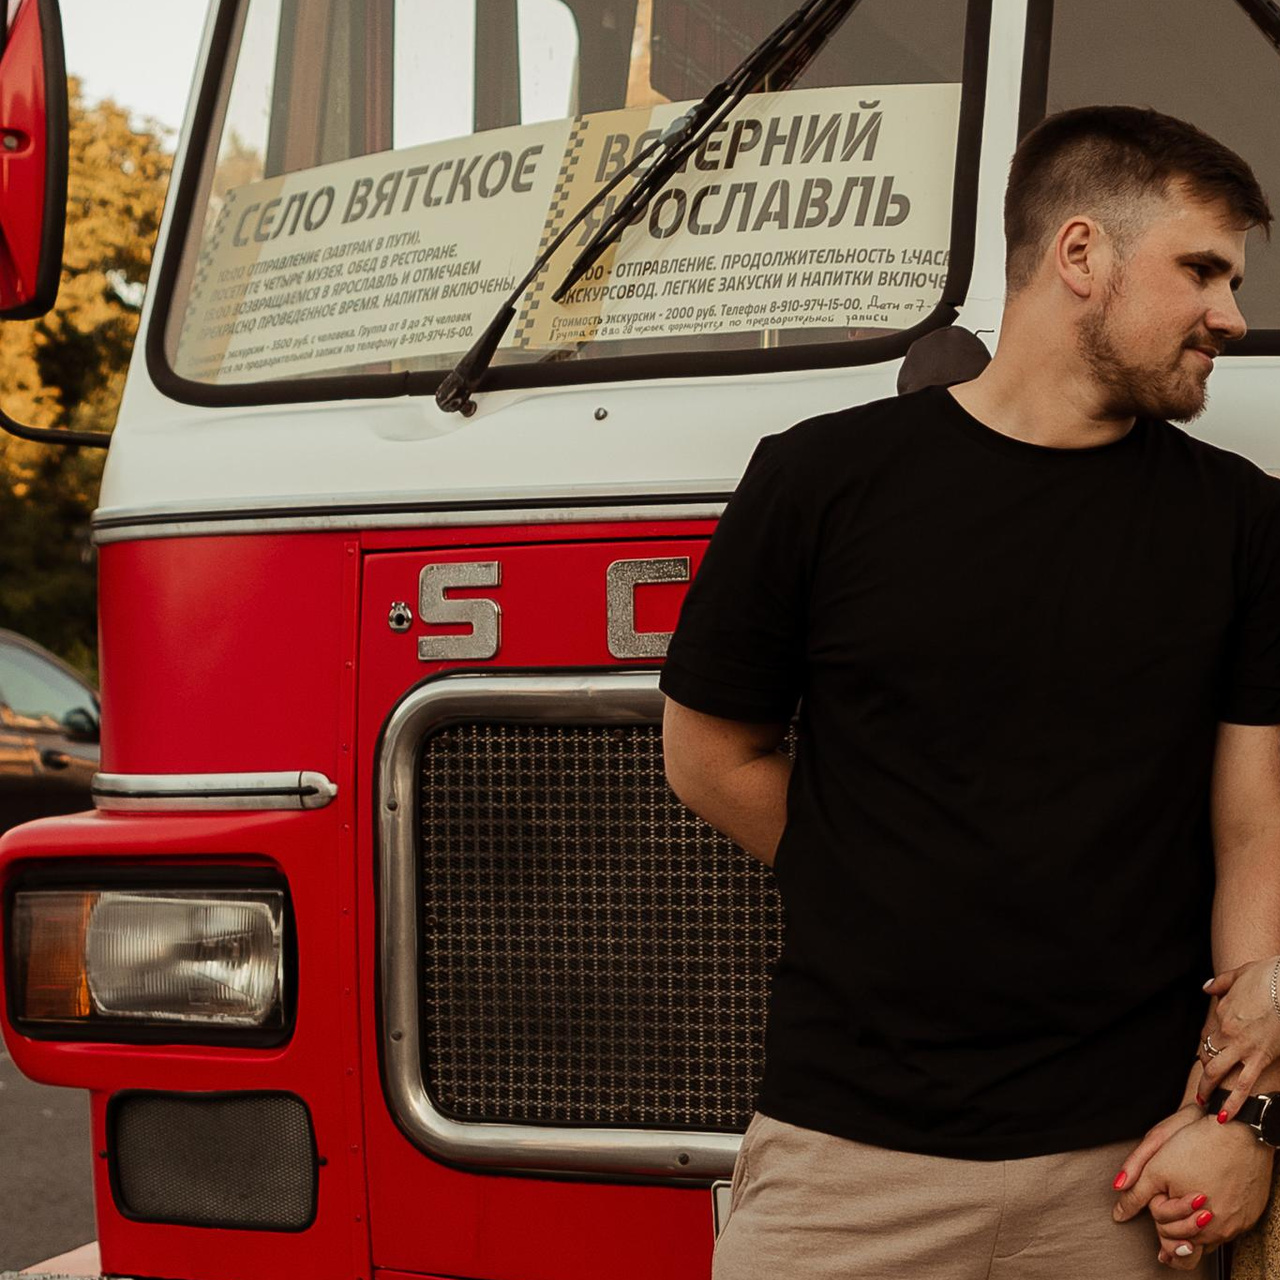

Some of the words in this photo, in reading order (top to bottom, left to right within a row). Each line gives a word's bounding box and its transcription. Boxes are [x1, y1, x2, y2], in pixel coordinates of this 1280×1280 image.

[594, 99, 883, 184] ВЕЕРНИЙ
[231, 185, 336, 248] СЕЛО
[341, 144, 544, 225] ВЯТСКОЕ
[248, 248, 321, 277] ОТПРАВЛЕНИЕ
[321, 238, 374, 263] (ЗАВТРАК
[375, 236, 385, 251] В
[385, 229, 421, 249] ПУТИ).
[263, 271, 306, 292] ЧЕТЫРЕ
[305, 264, 344, 283] МУЗЕЯ.
[347, 256, 380, 275] ОБЕД
[380, 254, 389, 269] В
[389, 243, 458, 268] РЕСТОРАНЕ.
[615, 255, 717, 279] ОТПРАВЛЕНИЕ.
[721, 248, 896, 271] ПРОДОЛЖИТЕЛЬНОСТЬ
[232, 287, 320, 317] ВОЗВРАЩАЕМСЯ
[320, 284, 330, 299] В
[331, 272, 399, 296] ЯРОСЛАВЛЬ
[400, 269, 411, 285] И
[412, 260, 482, 284] ОТМЕЧАЕМ
[257, 304, 337, 330] ПРОВЕДЕННОЕ
[338, 294, 380, 316] ВРЕМЯ.
[382, 284, 441, 308] НАПИТКИ
[441, 275, 517, 300] ВКЛЮЧЕНЫ.
[661, 276, 715, 297] ЛЕГКИЕ
[718, 273, 782, 292] ЗАКУСКИ
[786, 271, 797, 288] И
[800, 270, 873, 288] НАПИТКИ
[357, 322, 390, 338] Группа
[389, 321, 400, 332] от
[408, 319, 420, 331] до
[421, 315, 435, 328] 24
[435, 312, 472, 326] человек
[552, 315, 603, 328] Стоимость
[605, 310, 656, 325] экскурсии
[665, 306, 694, 320] 2000
[696, 305, 717, 321] руб.
[721, 301, 767, 318] Телефон
[769, 297, 863, 314] 8-910-974-15-00.
[356, 335, 398, 353] телефону
